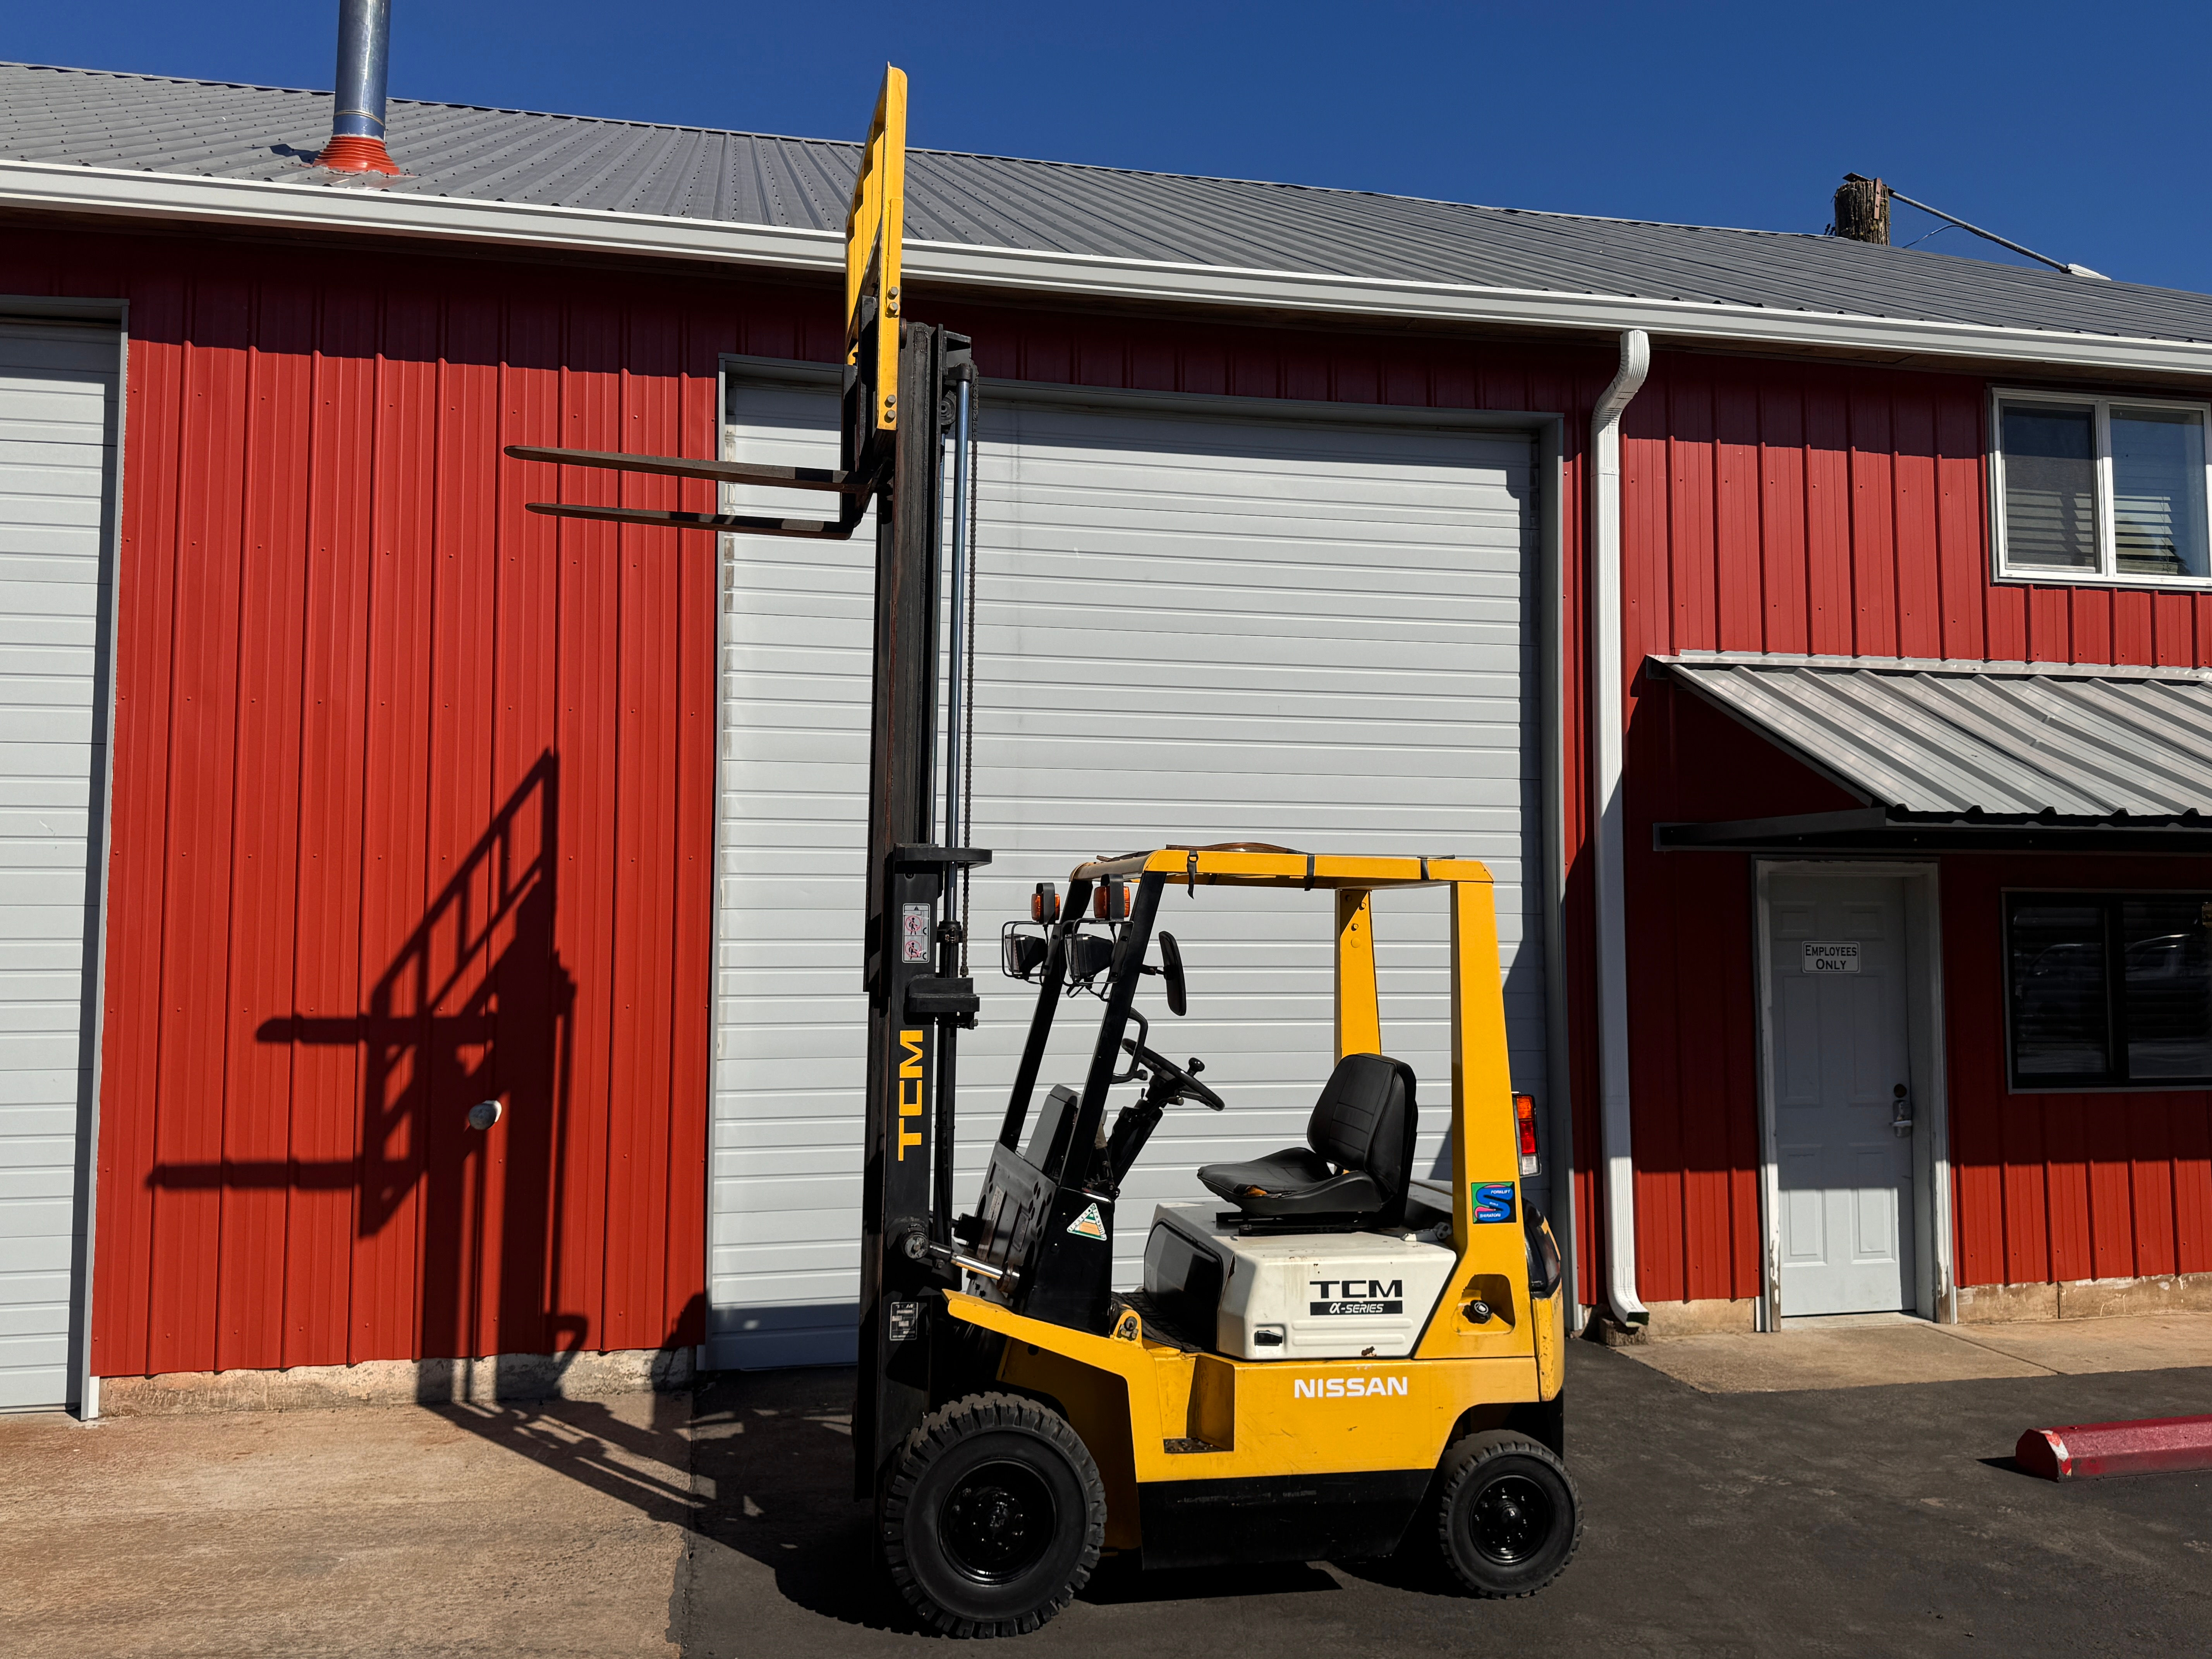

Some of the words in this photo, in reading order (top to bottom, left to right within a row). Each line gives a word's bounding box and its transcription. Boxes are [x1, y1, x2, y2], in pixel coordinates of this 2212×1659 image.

[1805, 945, 1856, 956] EMPLOYEES
[1816, 958, 1846, 970] ONLY
[898, 1030, 923, 1161] TCM
[1309, 1279, 1403, 1299] TCM
[1294, 1377, 1408, 1398] NISSAN
